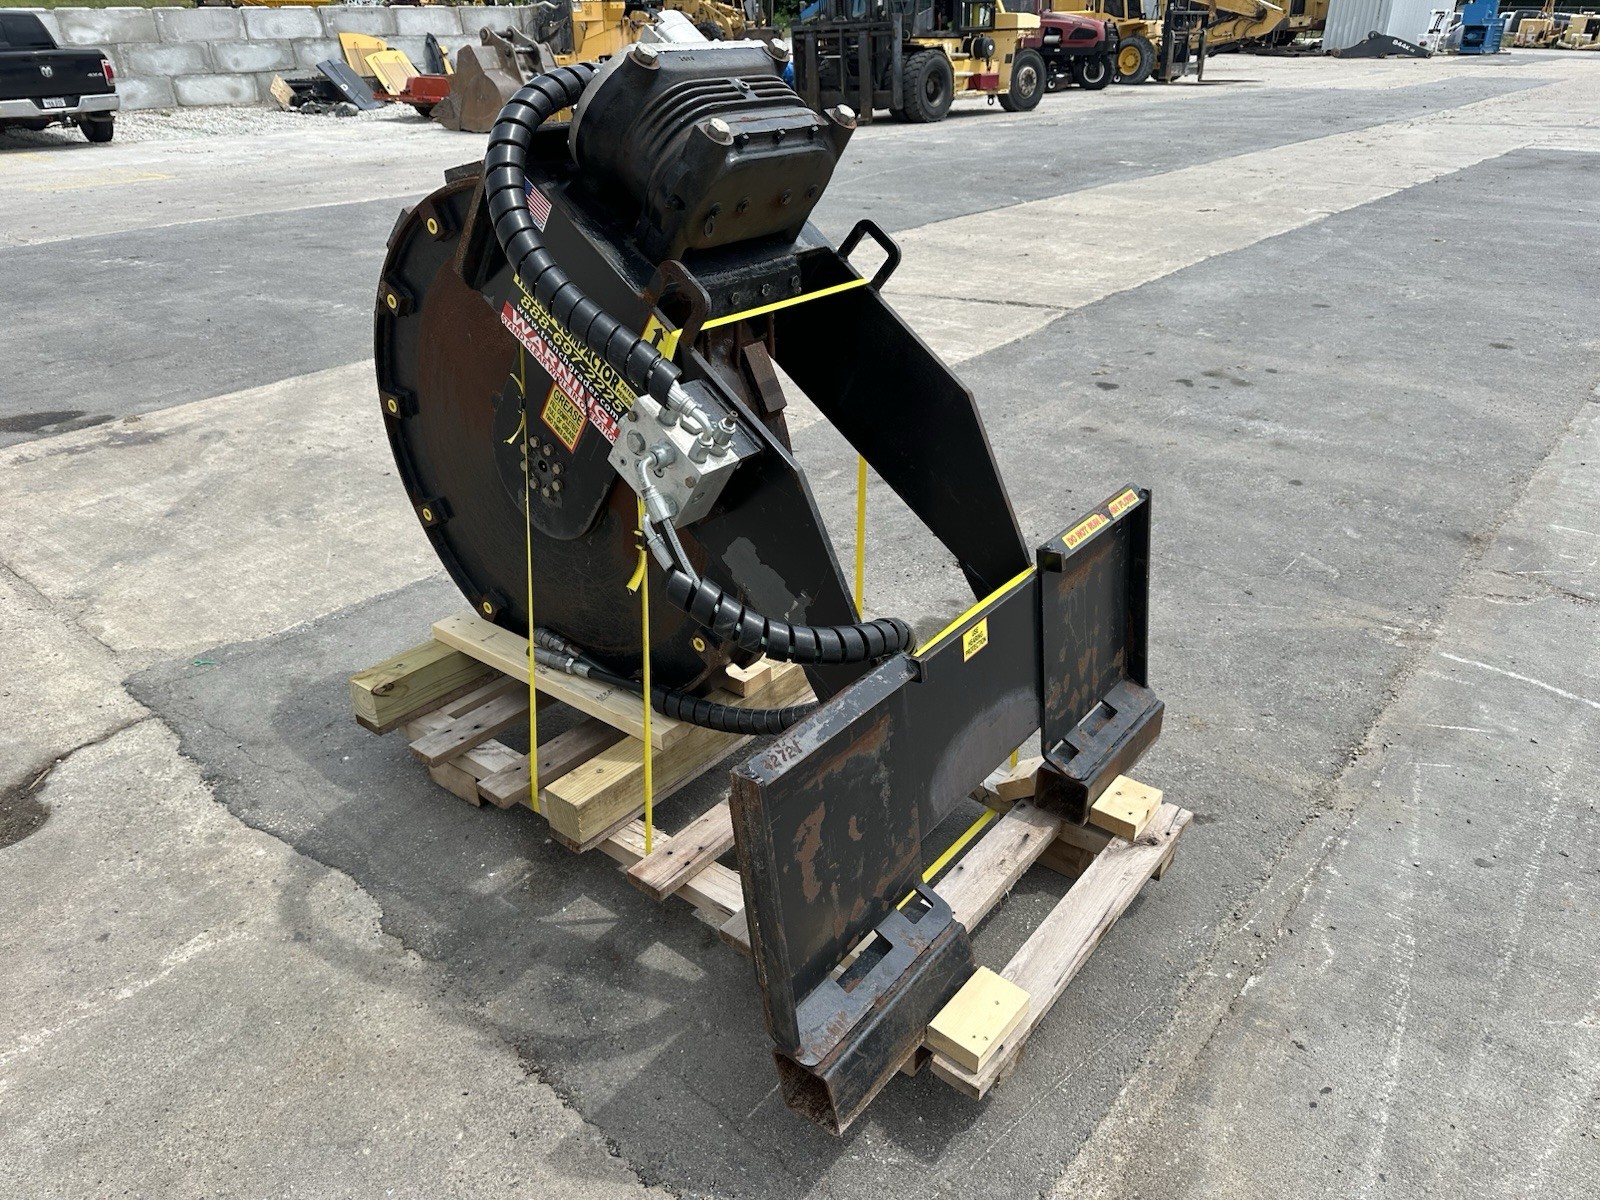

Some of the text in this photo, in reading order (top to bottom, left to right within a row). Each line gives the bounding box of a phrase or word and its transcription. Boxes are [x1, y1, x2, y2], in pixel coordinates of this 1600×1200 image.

[501, 313, 525, 341] STAND
[525, 340, 549, 367] CLEAR
[512, 308, 618, 434] WARNING!
[517, 304, 619, 421] www.trenchgrader.com
[520, 296, 625, 412] 888-697-2225
[553, 389, 583, 427] GREASE
[1075, 525, 1089, 540] NOT
